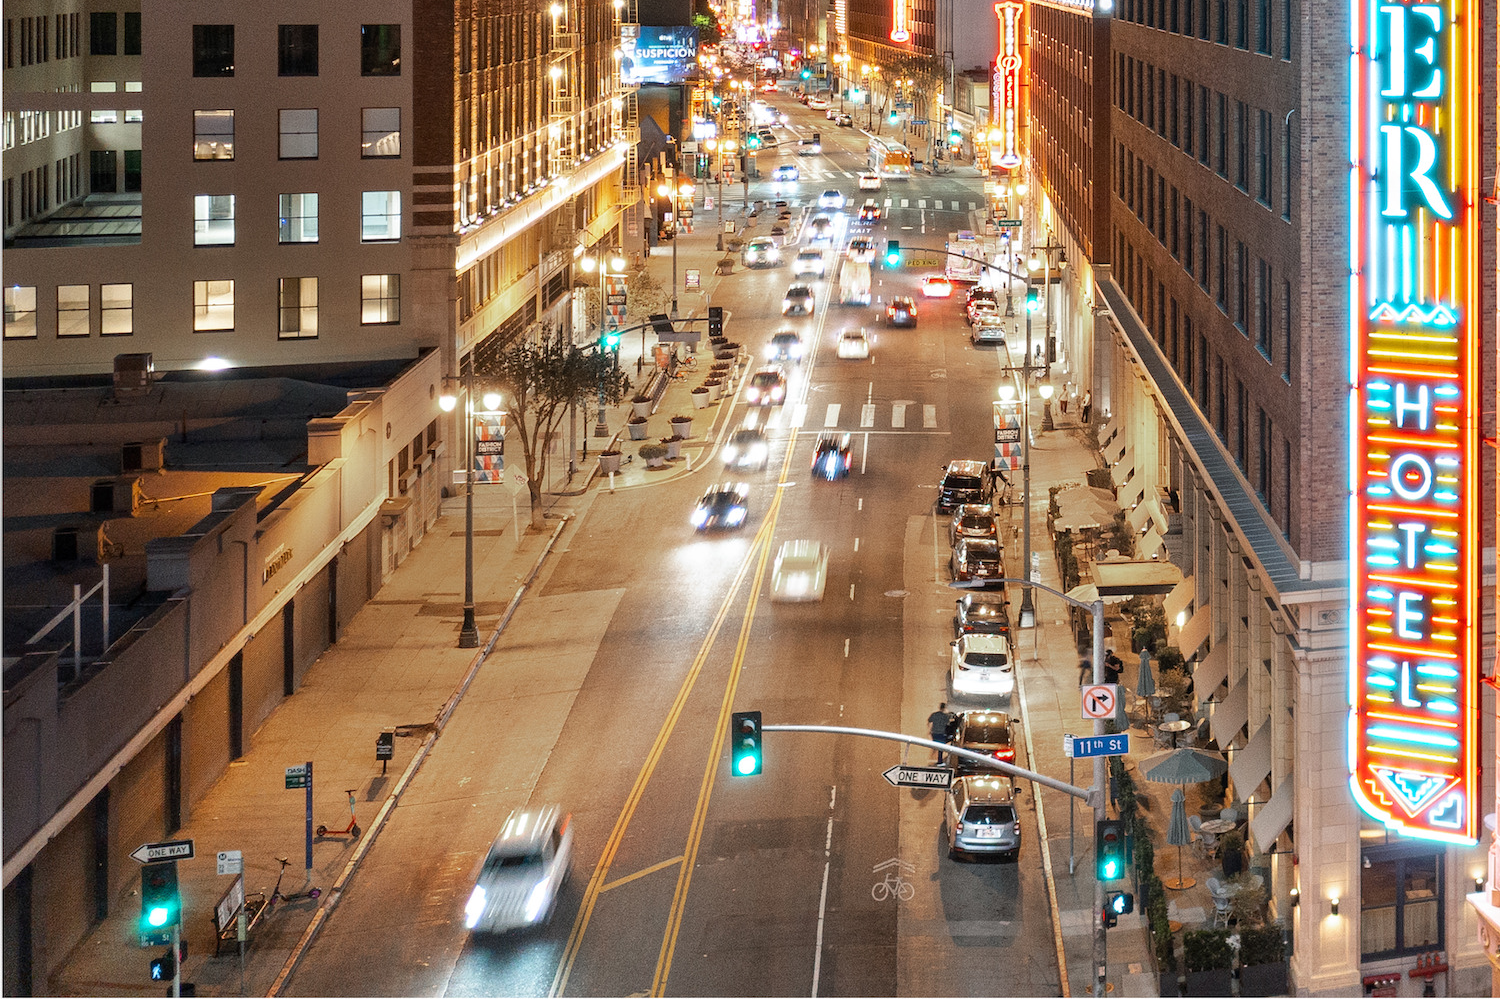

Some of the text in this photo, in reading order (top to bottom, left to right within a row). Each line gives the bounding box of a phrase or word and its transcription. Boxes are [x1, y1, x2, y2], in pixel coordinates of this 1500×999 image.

[636, 48, 696, 58] SUSPICION
[1390, 383, 1433, 708] HOTEL
[1080, 740, 1103, 754] 11th
[1109, 739, 1121, 750] St
[898, 771, 946, 783] ONE WAY
[148, 846, 187, 857] ONE WAY
